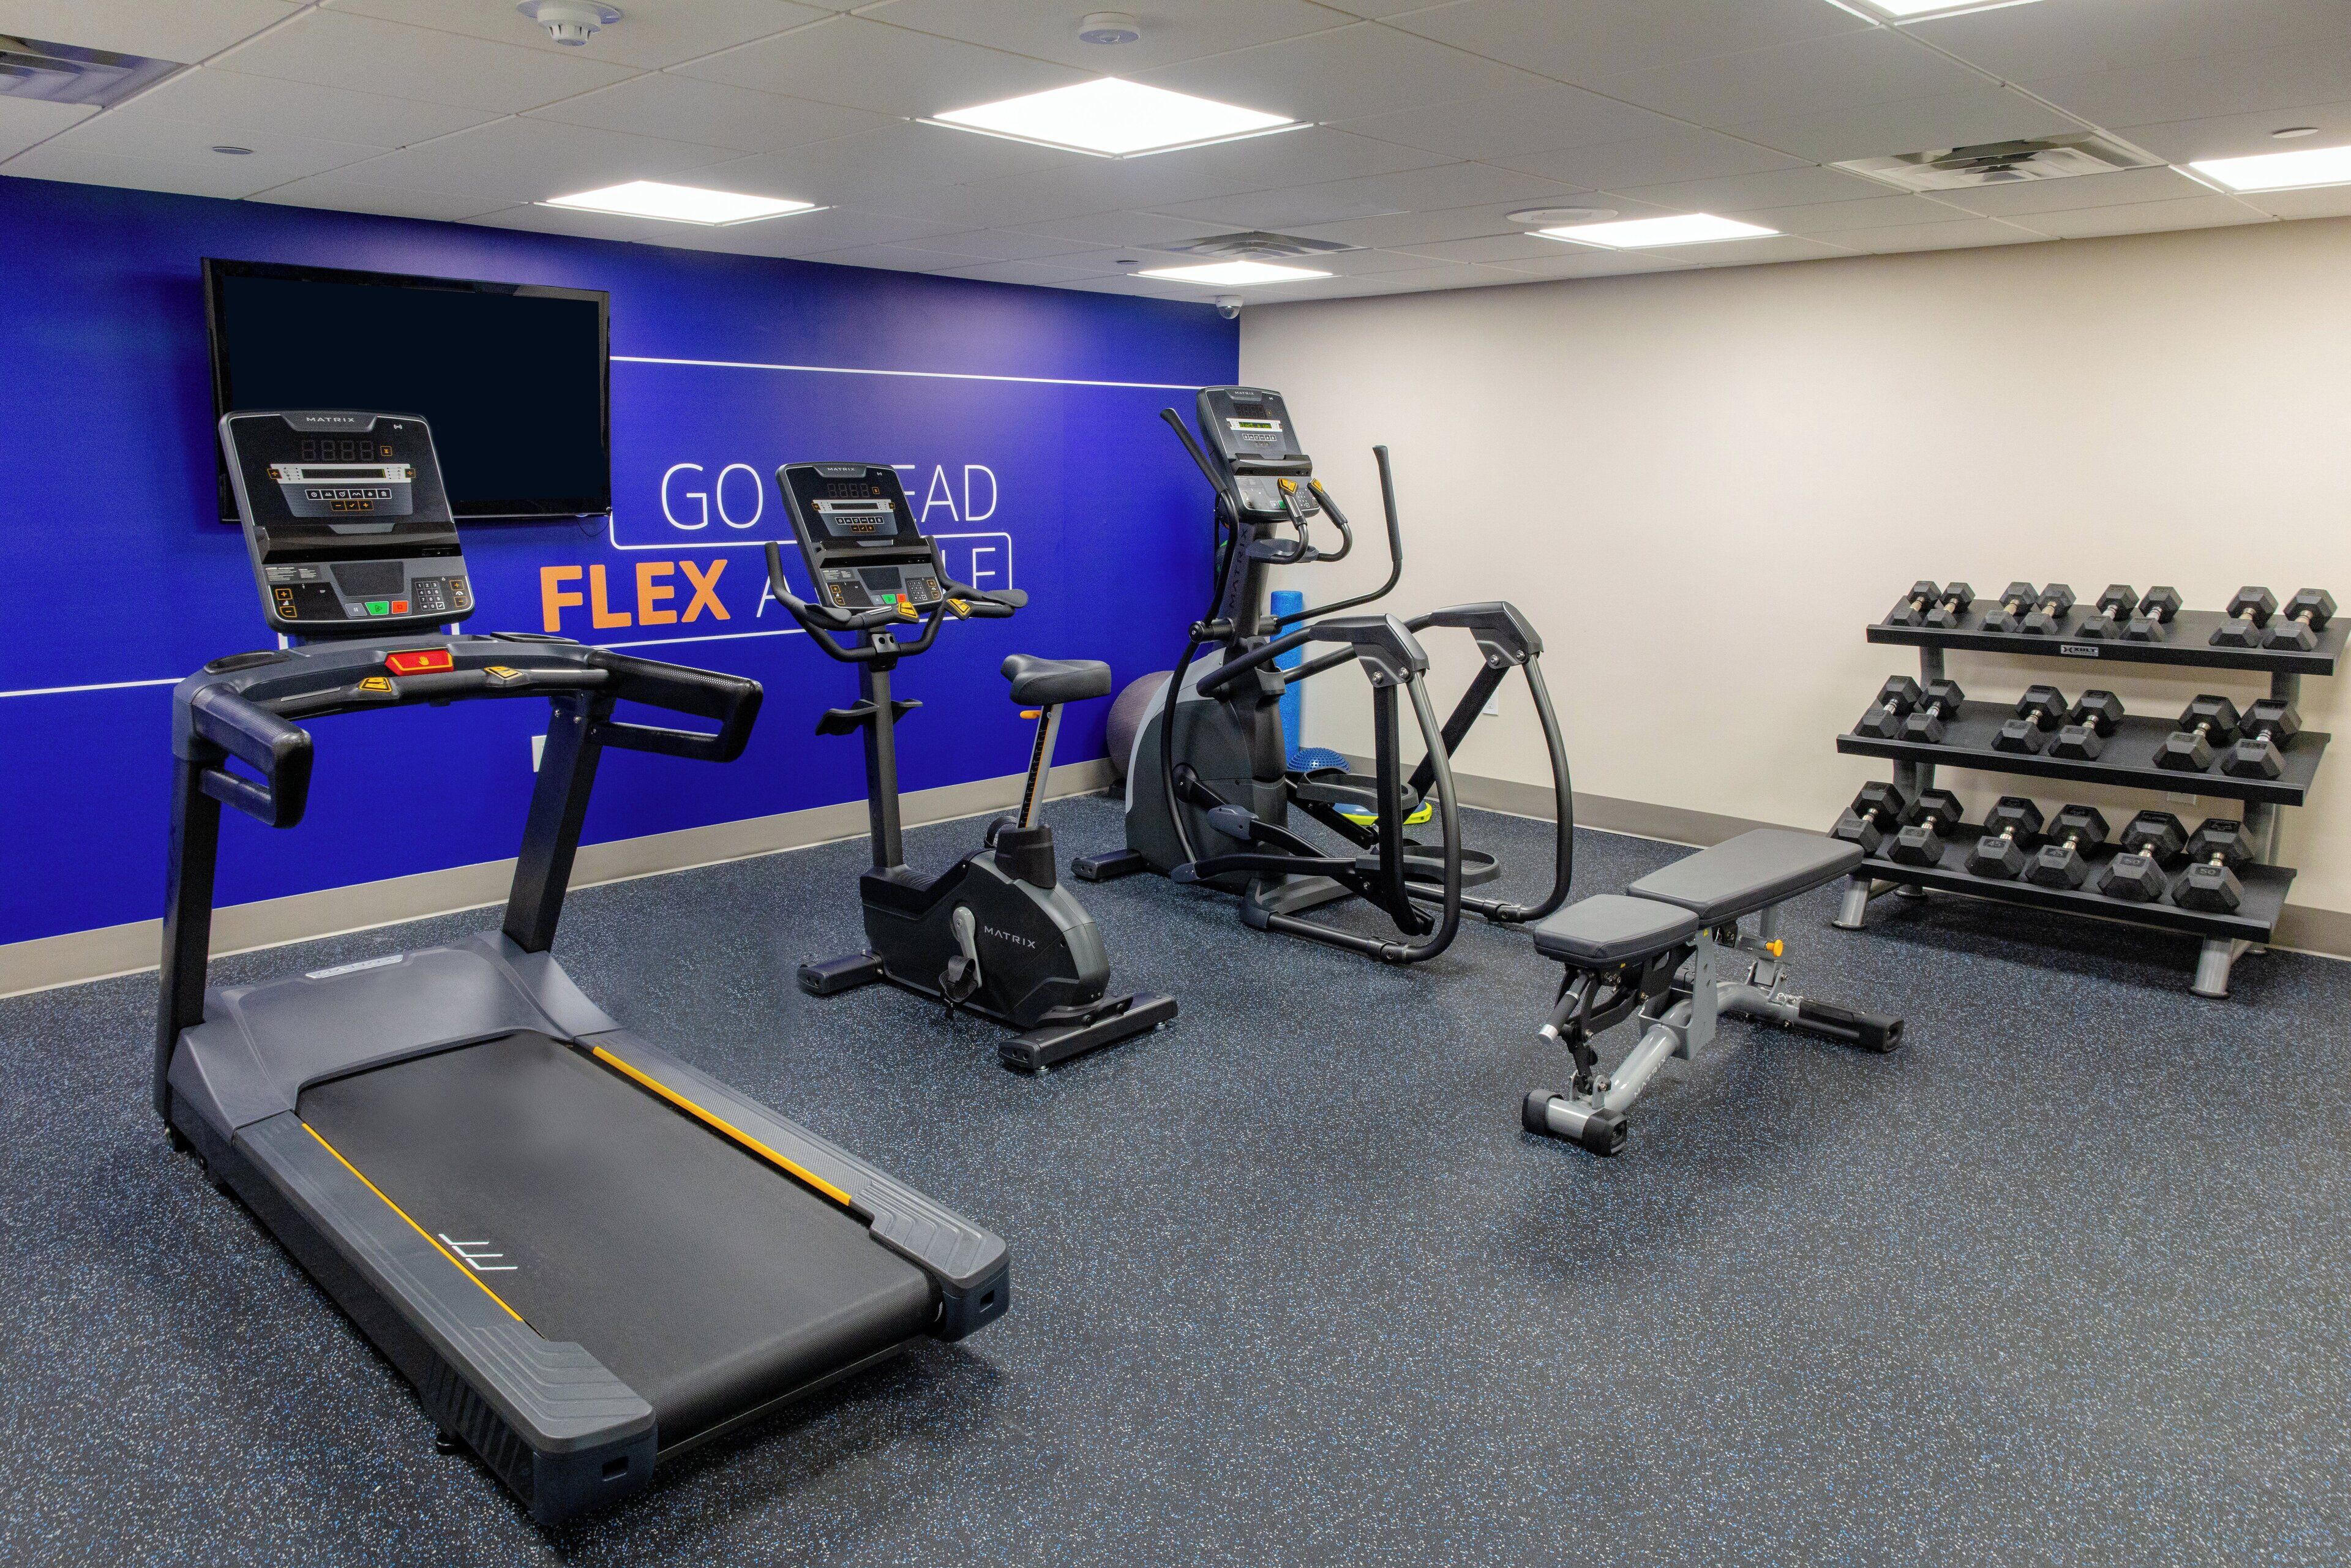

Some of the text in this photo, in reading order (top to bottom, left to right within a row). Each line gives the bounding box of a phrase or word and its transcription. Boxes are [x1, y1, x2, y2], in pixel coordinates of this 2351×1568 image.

[662, 463, 763, 530] GO
[540, 558, 731, 632] FLEX
[1228, 528, 1248, 609] MATRIX
[984, 925, 1036, 950] MATRIX
[1633, 1056, 1666, 1098] MATRIX
